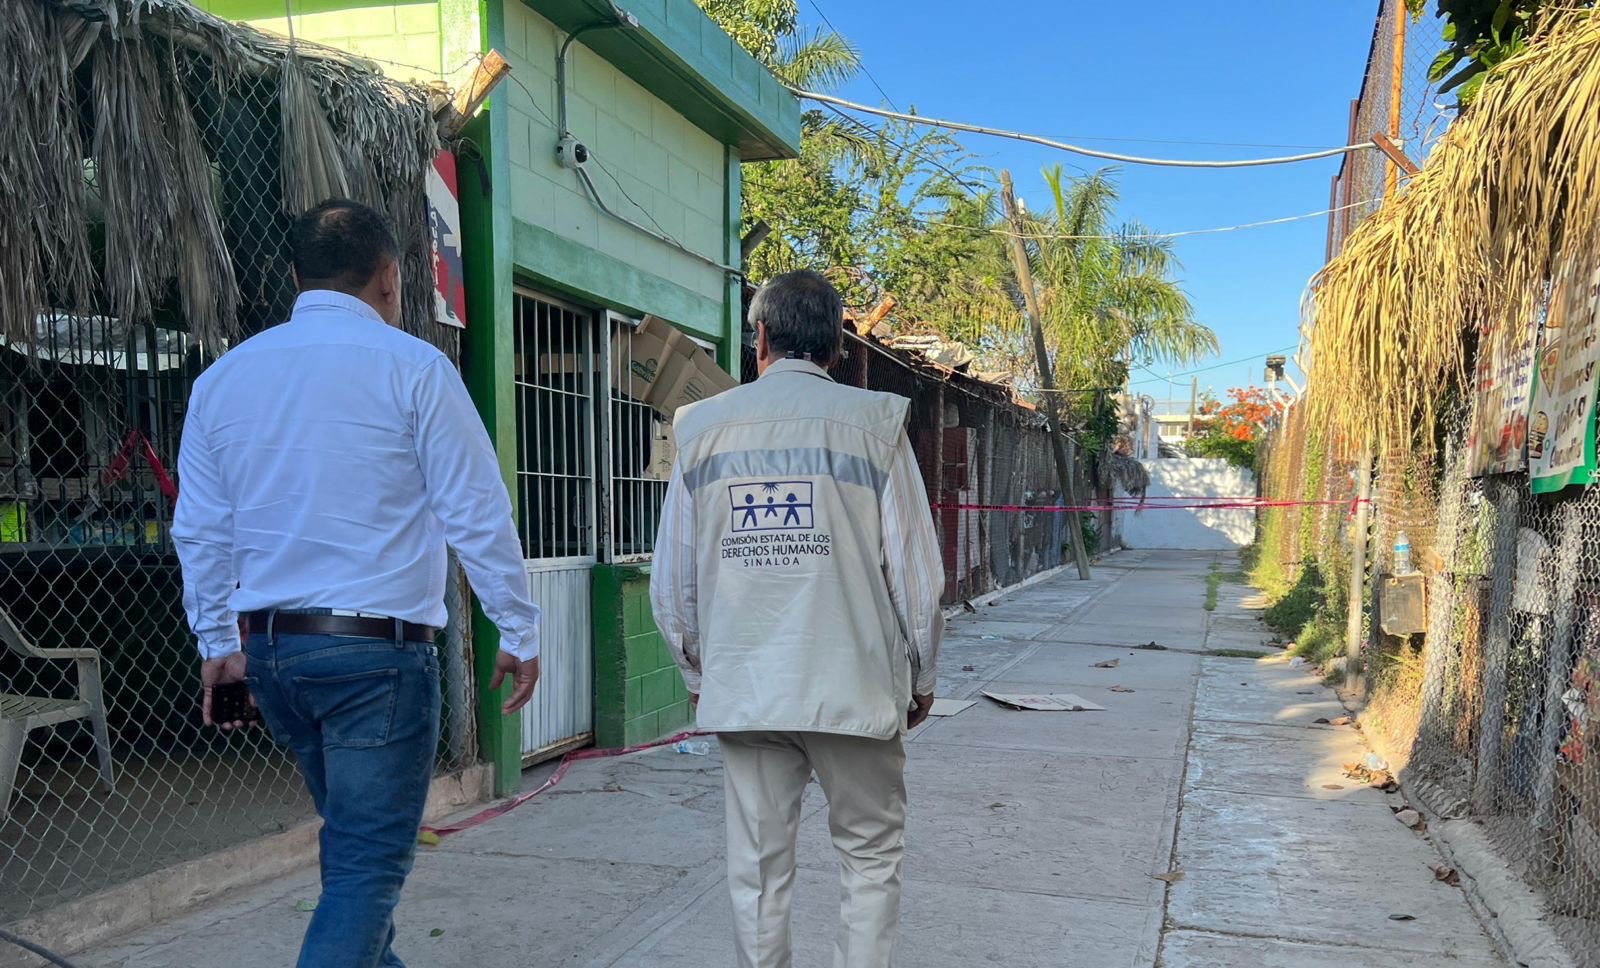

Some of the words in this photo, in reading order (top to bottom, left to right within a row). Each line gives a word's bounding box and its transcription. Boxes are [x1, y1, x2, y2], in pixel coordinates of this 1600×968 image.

[722, 534, 758, 547] COMISIÓN
[760, 534, 796, 543] ESTATAL
[798, 533, 811, 542] DE
[813, 534, 830, 543] LOS
[722, 545, 769, 558] DERECHOS
[772, 544, 830, 556] HUMANOS
[744, 557, 800, 567] SINALOA
